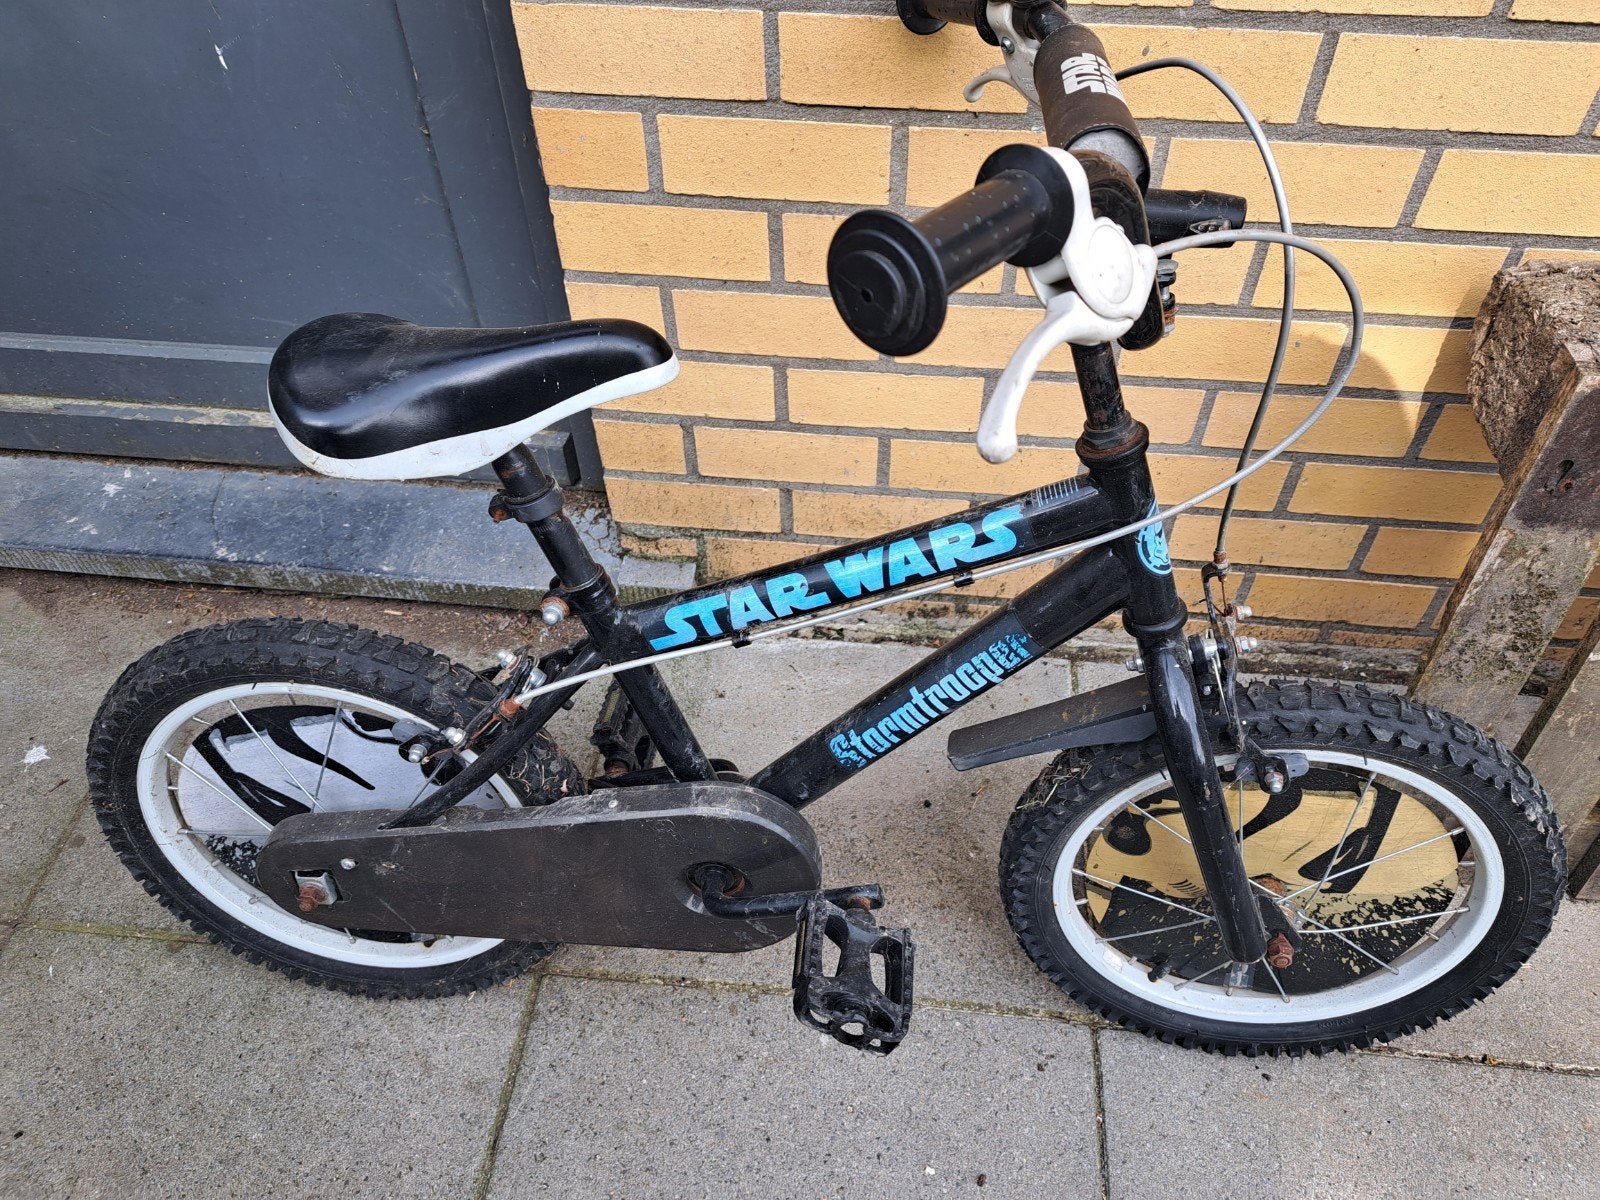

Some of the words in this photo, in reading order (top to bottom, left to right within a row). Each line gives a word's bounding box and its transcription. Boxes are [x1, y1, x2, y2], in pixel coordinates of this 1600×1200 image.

[649, 572, 832, 651] STAR
[823, 504, 1024, 599] WARS
[829, 633, 1033, 769] Stormtrooper
